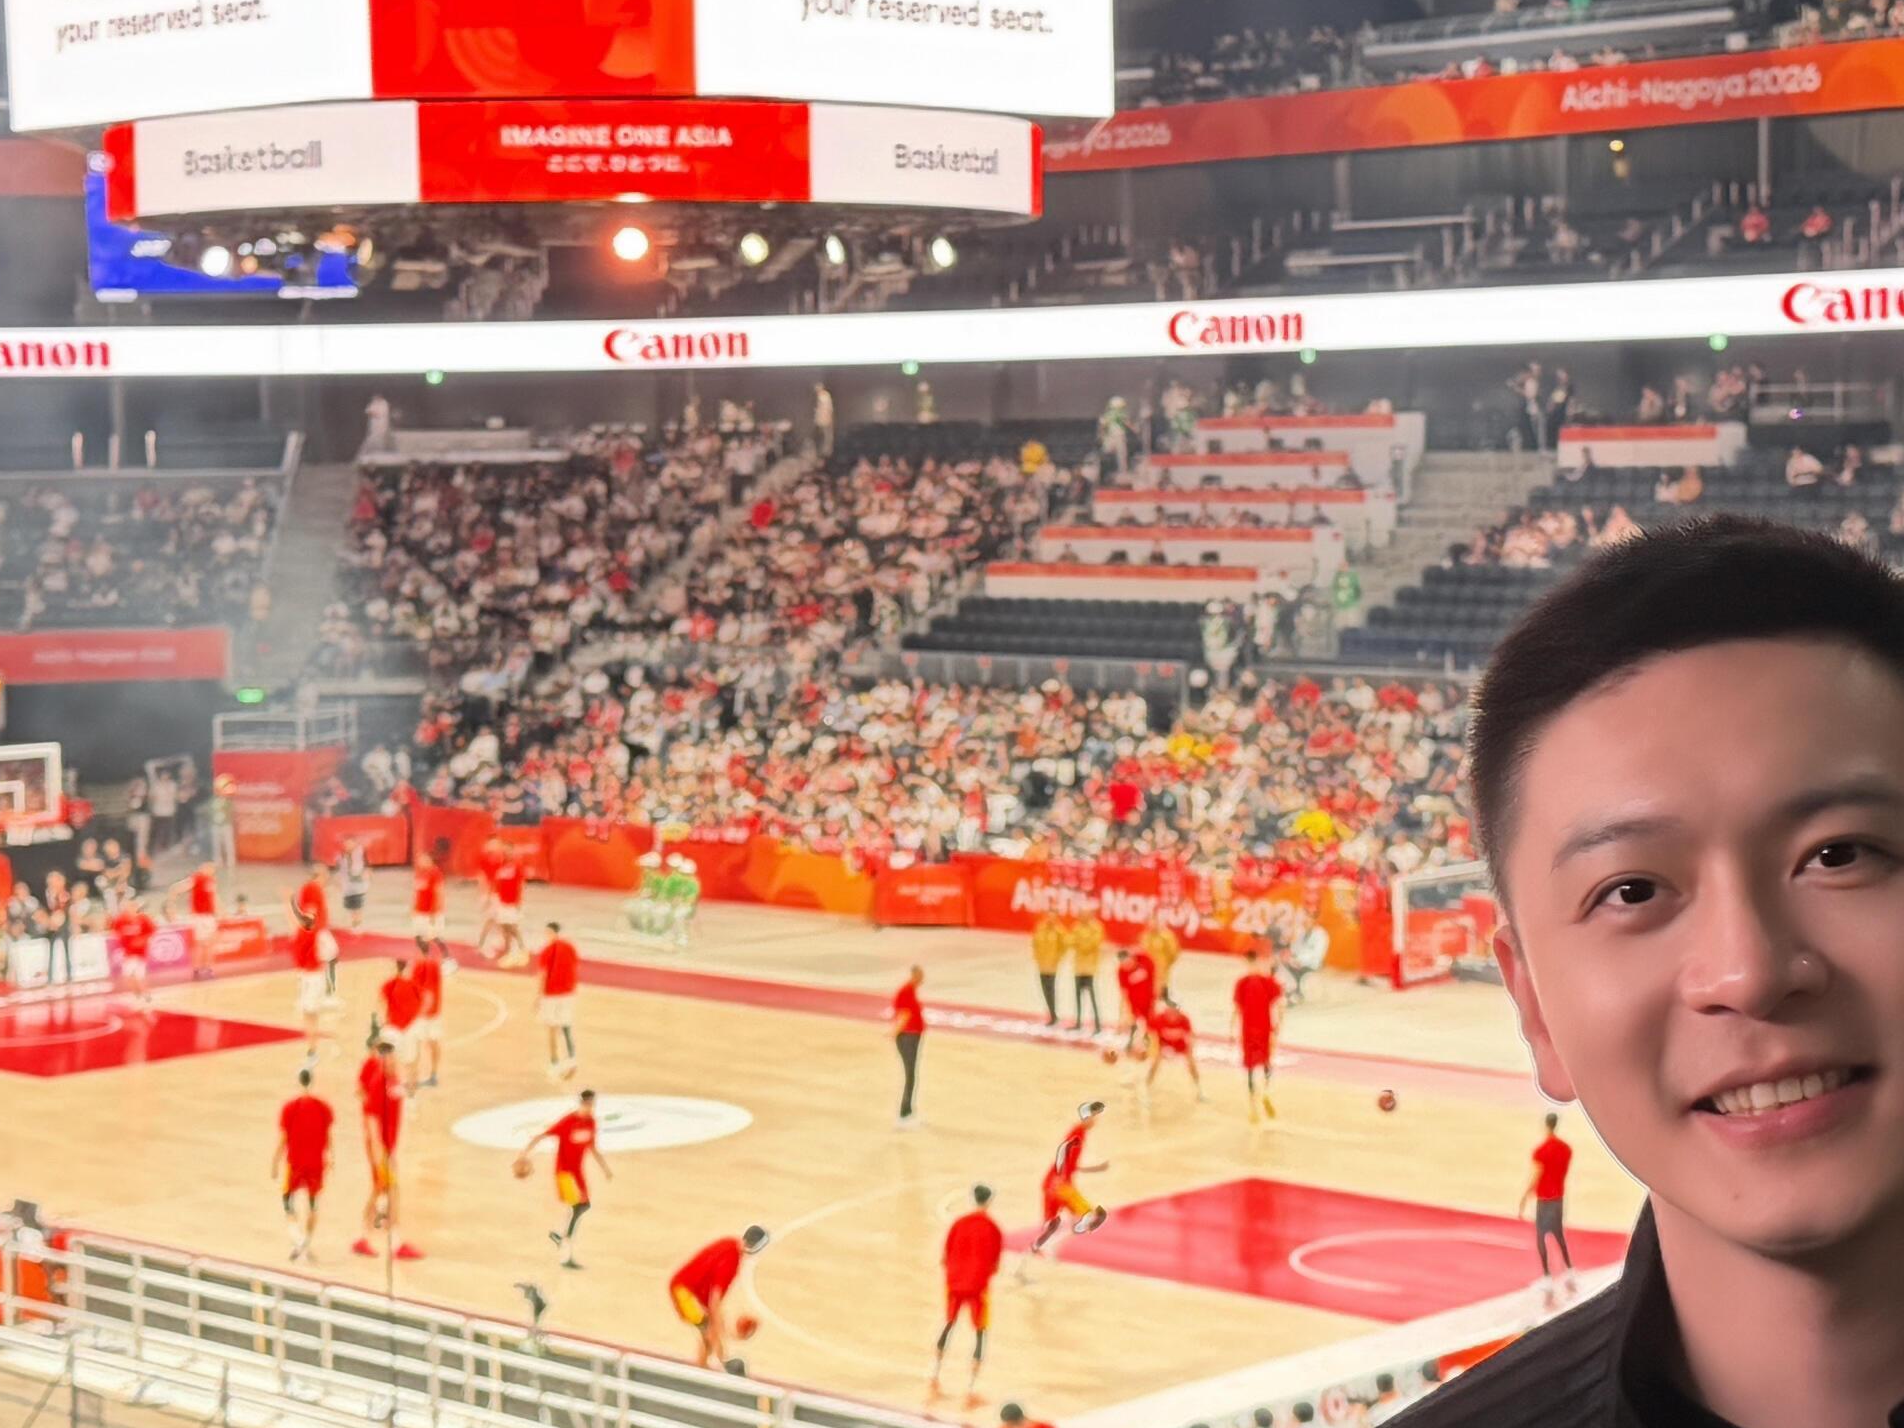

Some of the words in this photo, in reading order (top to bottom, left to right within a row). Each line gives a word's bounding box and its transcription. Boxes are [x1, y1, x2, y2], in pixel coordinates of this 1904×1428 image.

[988, 7, 1054, 34] seat.
[499, 124, 612, 148] IMAGINE
[614, 124, 671, 147] ONE
[673, 125, 734, 148] ASIA
[1168, 311, 1304, 346] Canon
[603, 329, 750, 362] Canon
